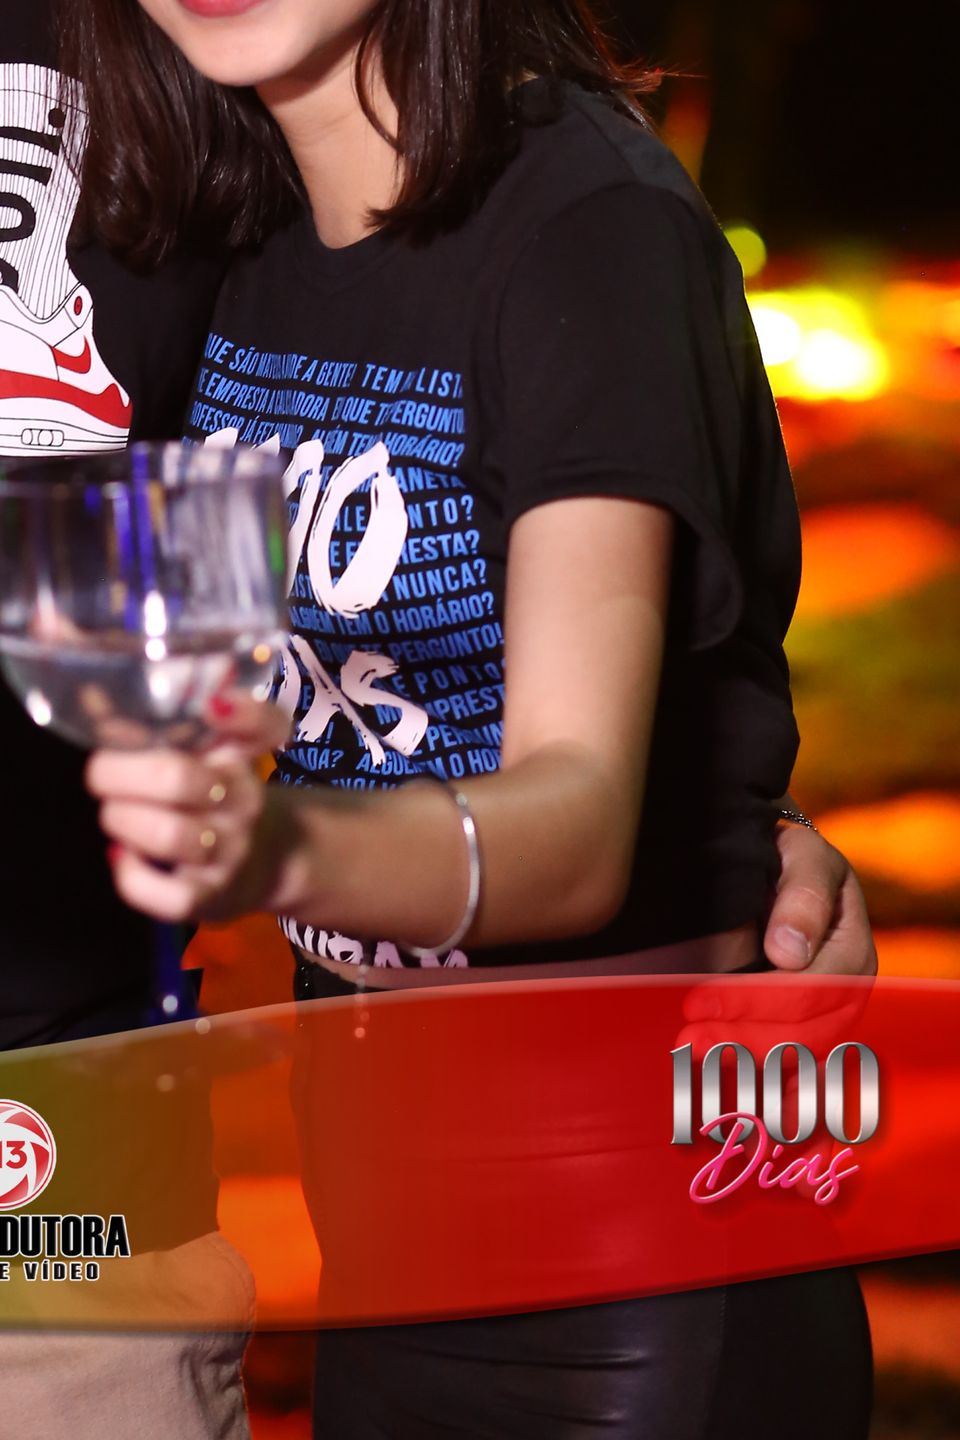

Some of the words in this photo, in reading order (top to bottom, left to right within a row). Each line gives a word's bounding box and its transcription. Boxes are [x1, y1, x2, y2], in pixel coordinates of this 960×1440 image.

[316, 361, 358, 388] GENTE!
[385, 431, 465, 471] HORÁRIO?
[394, 558, 487, 601] NUNCA?
[374, 611, 390, 634] O
[394, 590, 495, 633] HORÁRIO?
[388, 621, 505, 664] PERGUNTO!
